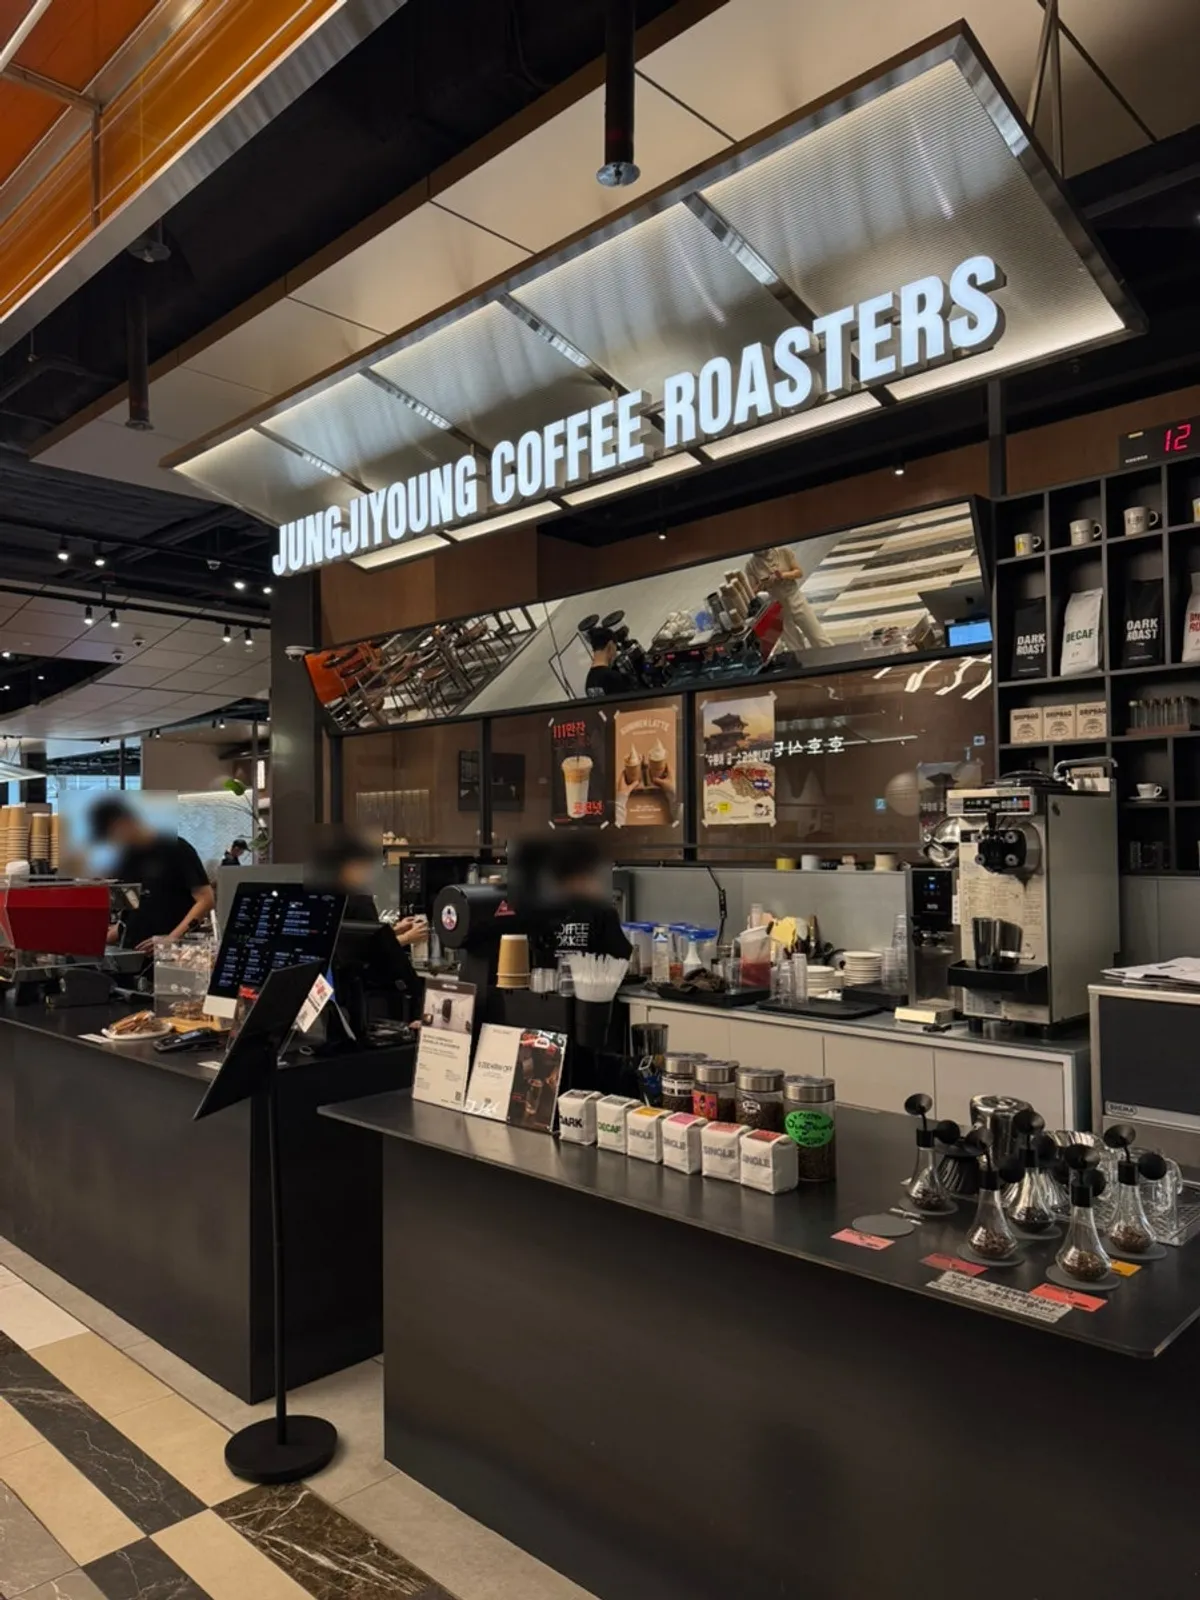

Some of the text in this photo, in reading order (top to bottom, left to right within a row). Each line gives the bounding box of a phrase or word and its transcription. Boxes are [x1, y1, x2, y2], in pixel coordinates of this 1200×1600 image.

[271, 254, 1000, 577] JUNGJIYOUNG COFFEE ROASTERS
[1164, 424, 1192, 452] 12
[1126, 617, 1159, 631] DARK
[1017, 633, 1046, 646] DARK
[1066, 628, 1095, 643] DECAF
[1126, 629, 1158, 641] ROAST
[1016, 644, 1045, 656] ROAST
